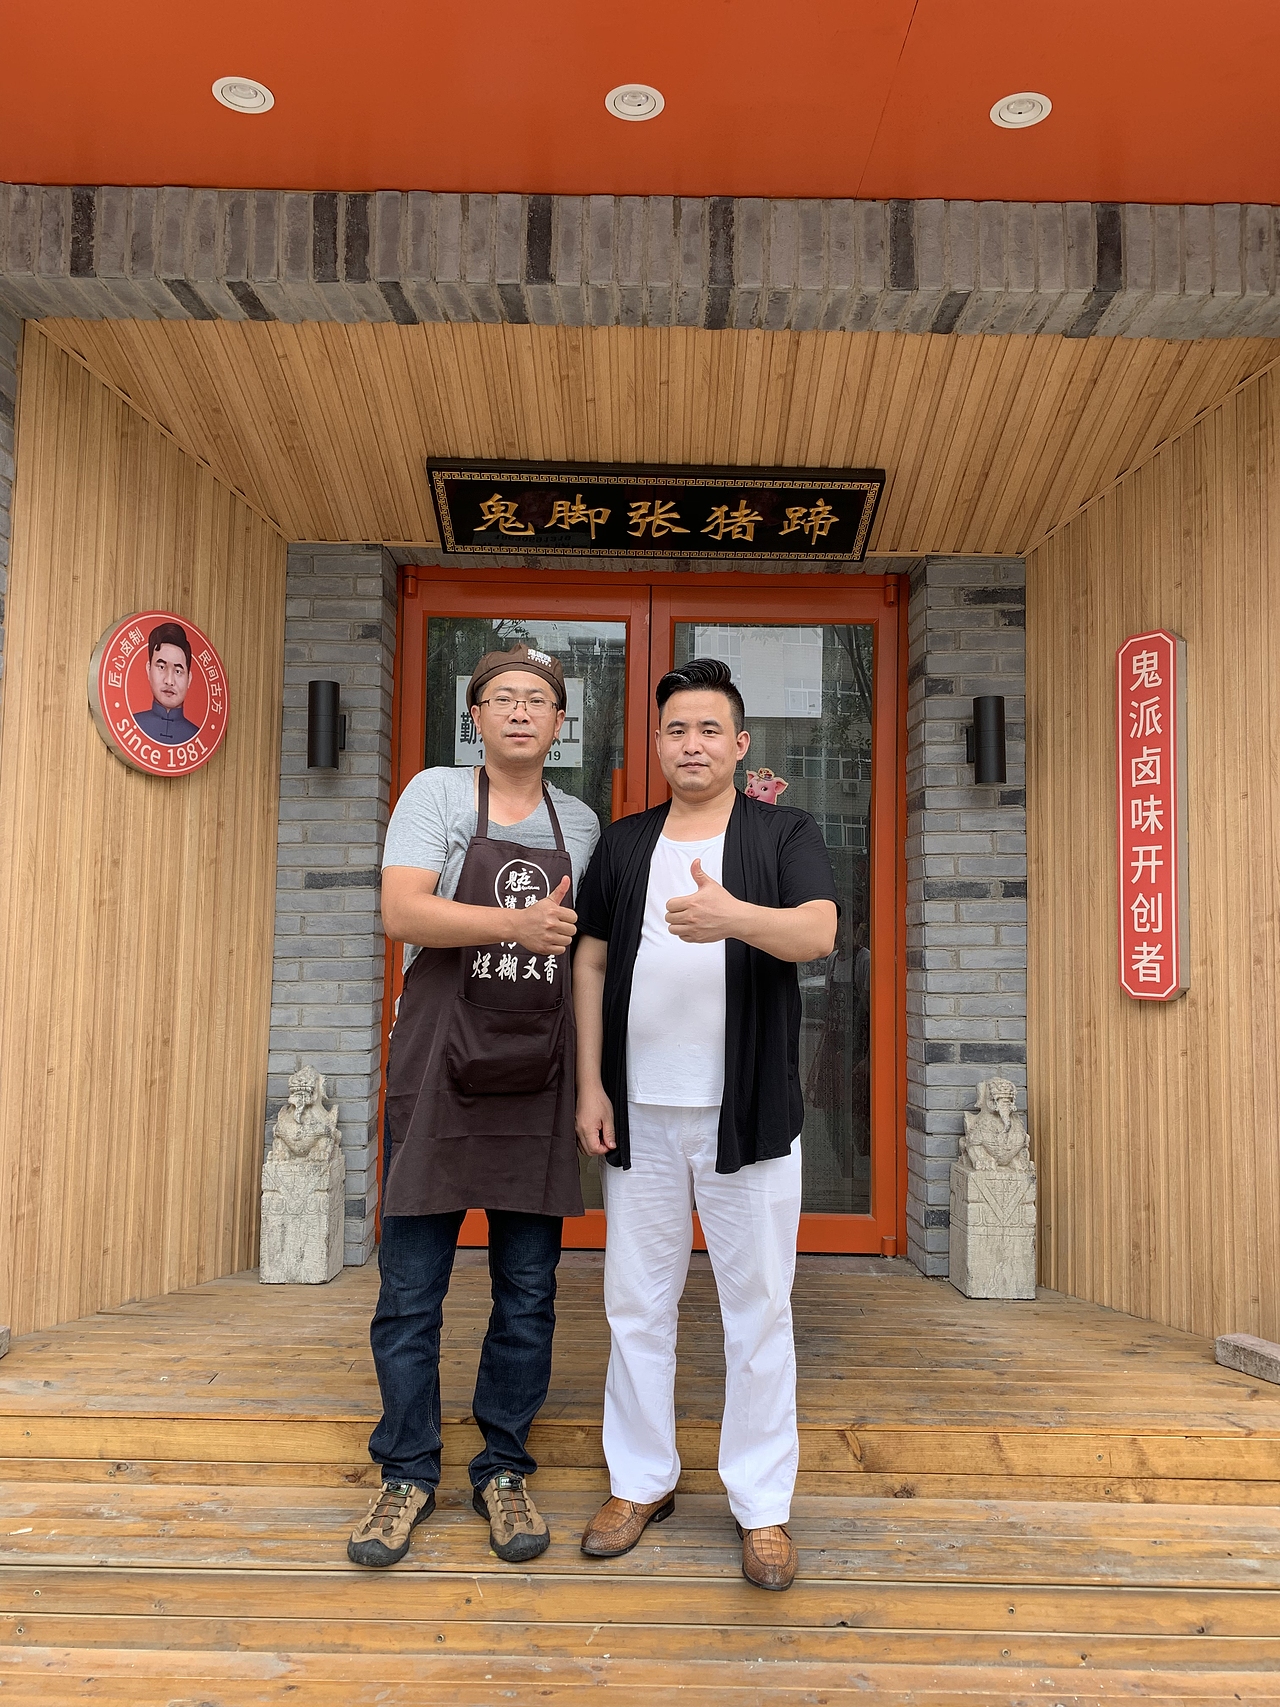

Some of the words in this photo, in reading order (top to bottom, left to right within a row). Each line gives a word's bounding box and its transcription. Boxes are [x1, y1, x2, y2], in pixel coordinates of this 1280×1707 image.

[473, 493, 840, 546] 鬼脚张猪蹄
[108, 626, 145, 688] 匠心卤制
[198, 650, 223, 715] 民间古方
[166, 736, 208, 767] 1981
[1129, 649, 1165, 983] 鬼派卤味开创者
